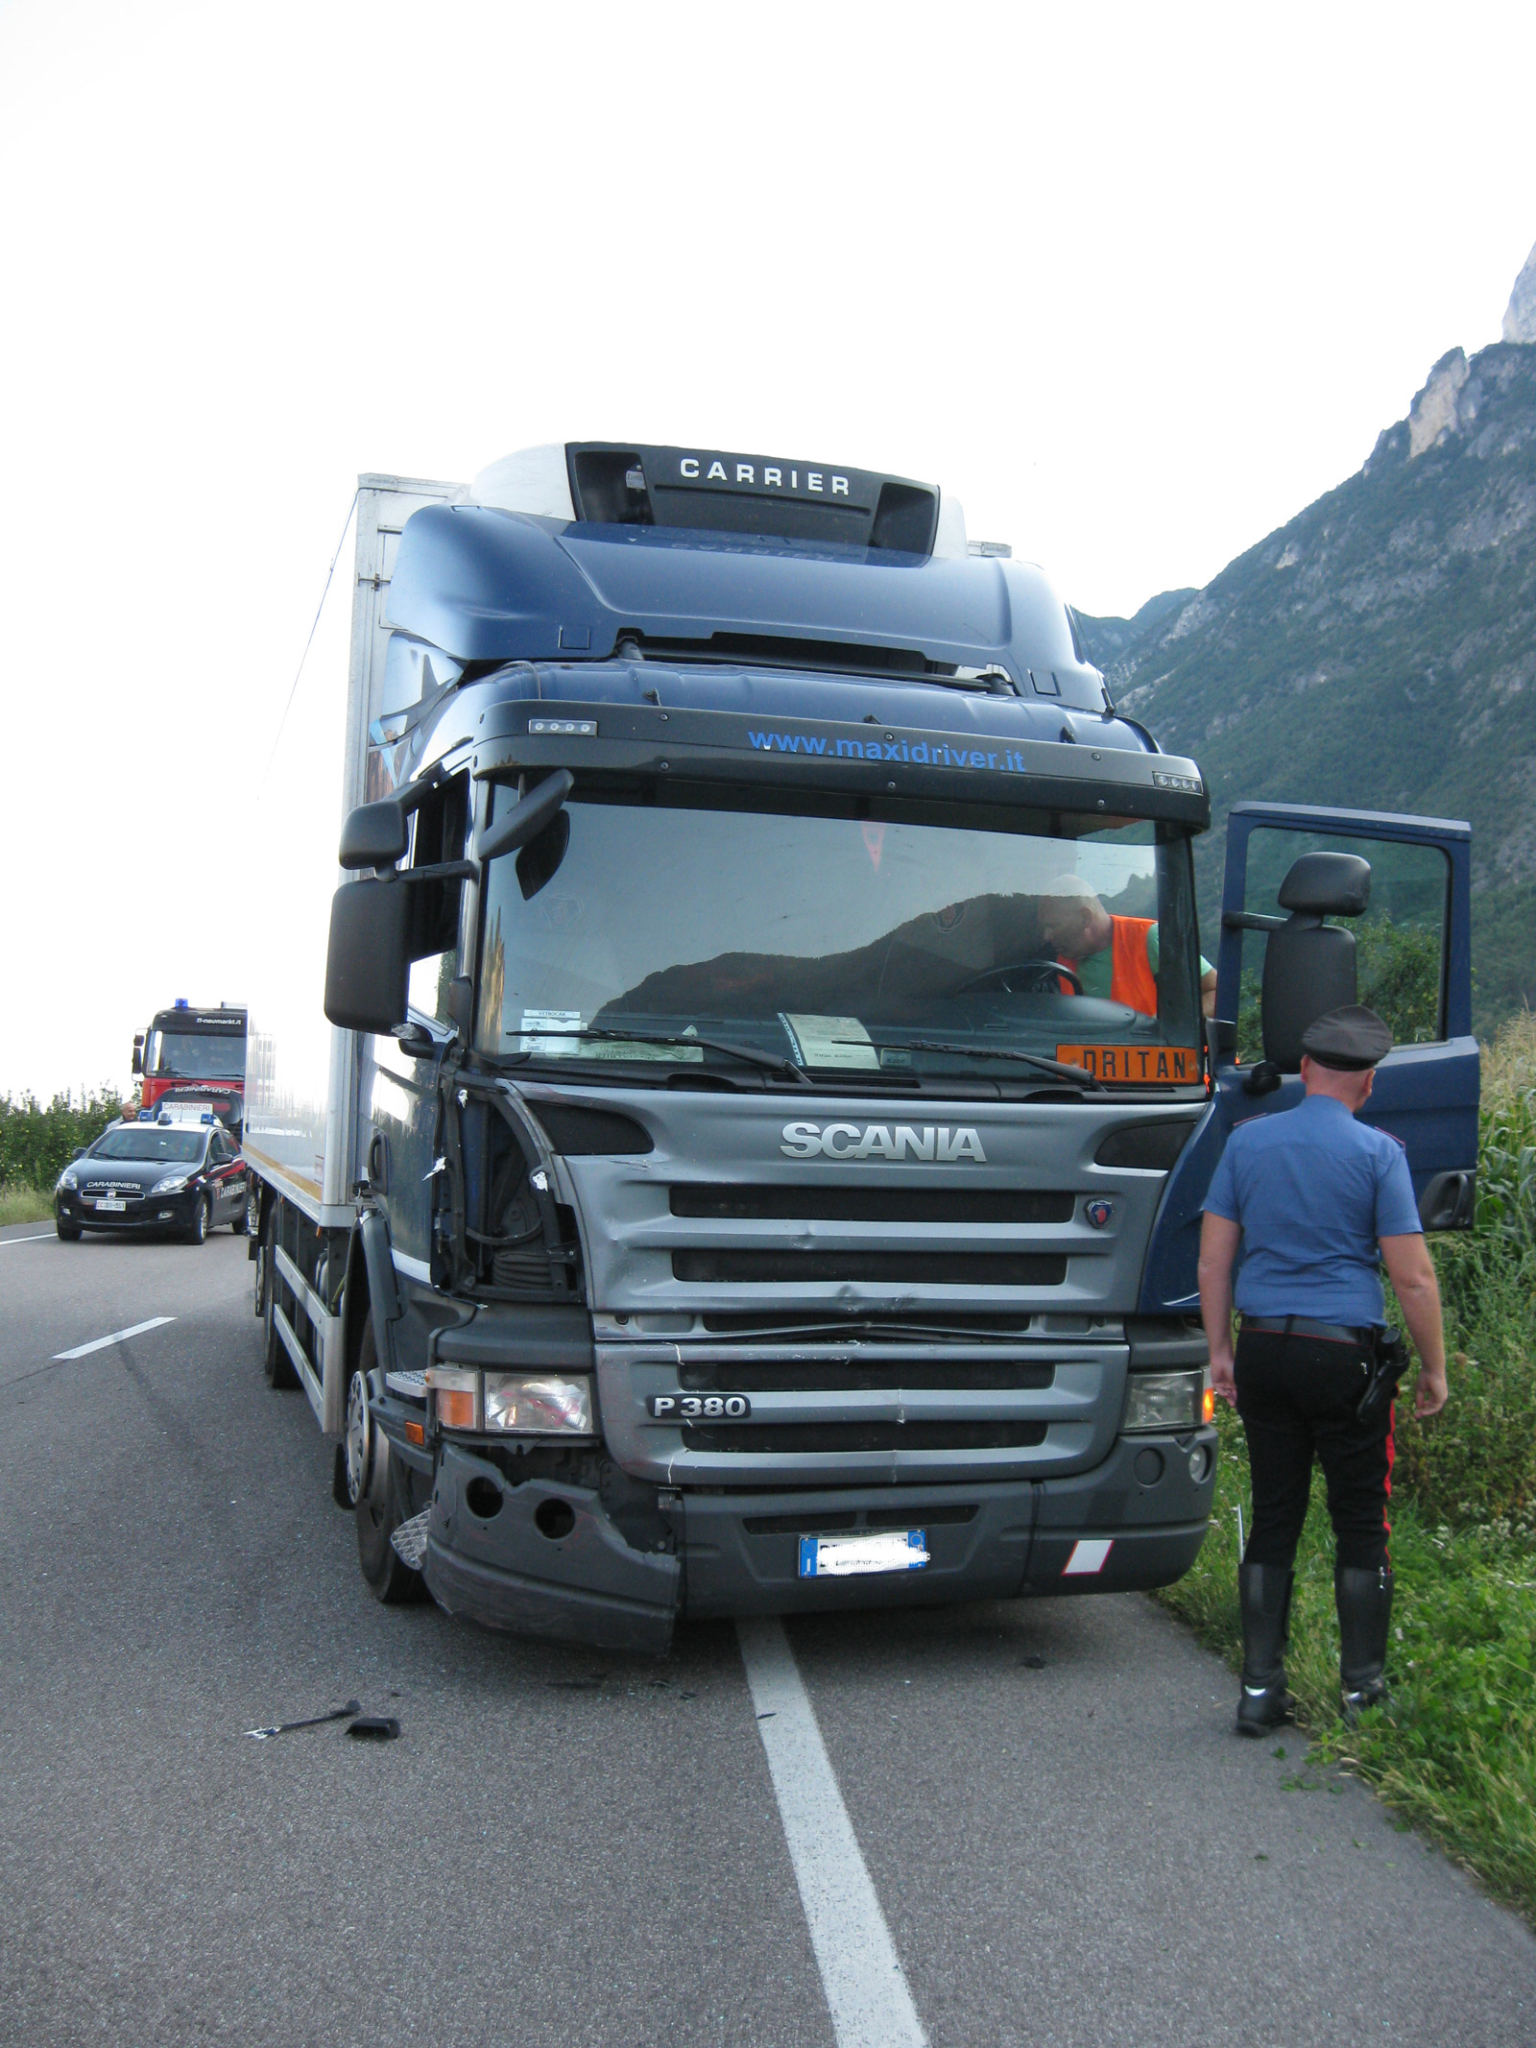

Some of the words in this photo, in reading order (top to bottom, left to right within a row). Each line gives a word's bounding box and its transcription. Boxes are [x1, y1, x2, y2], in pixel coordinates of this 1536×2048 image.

[680, 458, 850, 496] CARRIER
[748, 730, 1025, 773] www.maxidriver.it
[1083, 1049, 1186, 1078] DRITAN
[163, 1103, 210, 1112] CARABINIERI
[780, 1122, 987, 1162] SCANIA
[86, 1181, 141, 1190] CARABINIERI
[654, 1397, 675, 1417] P
[680, 1397, 746, 1417] 380
